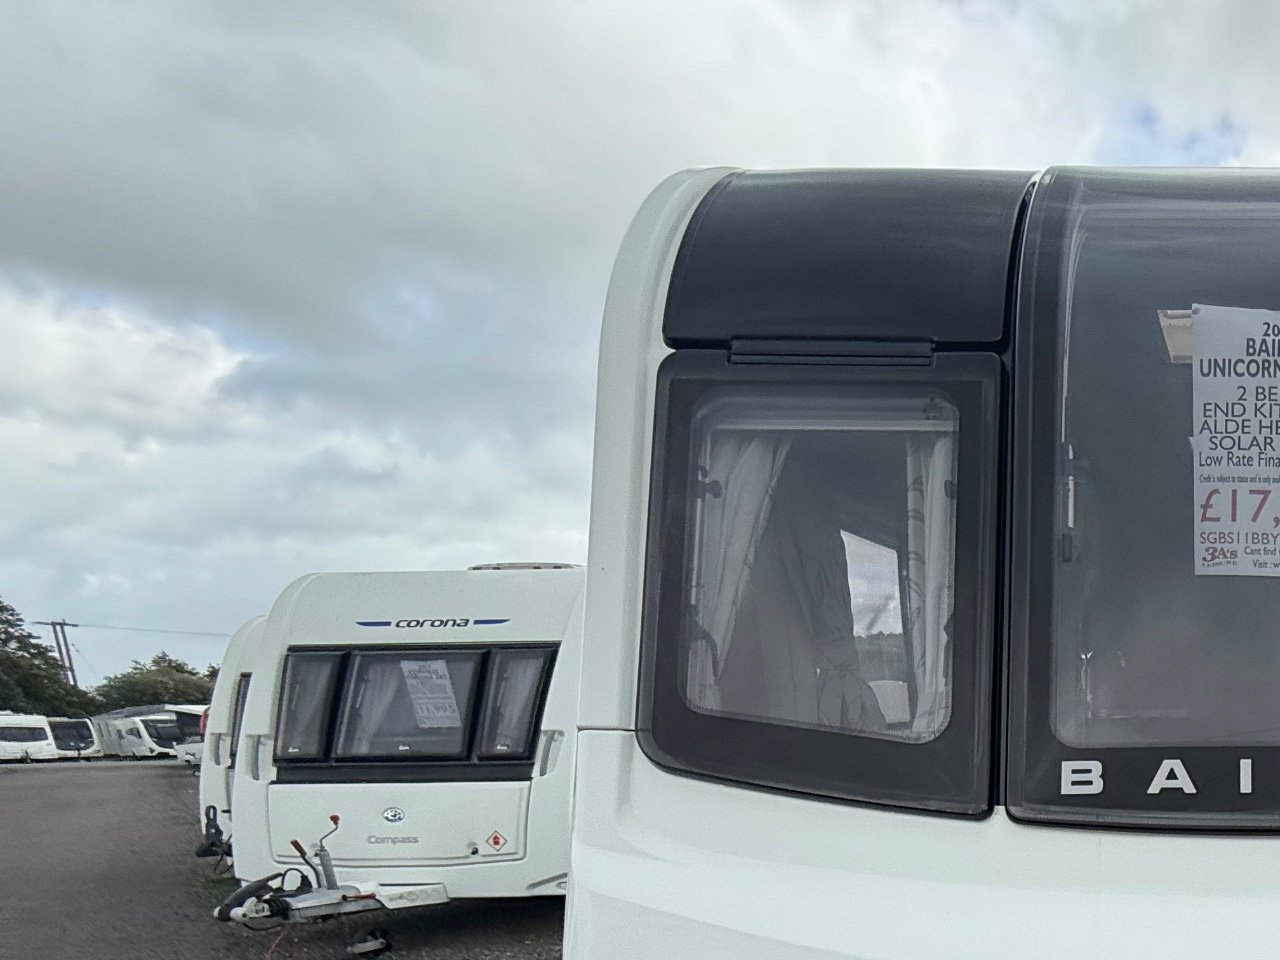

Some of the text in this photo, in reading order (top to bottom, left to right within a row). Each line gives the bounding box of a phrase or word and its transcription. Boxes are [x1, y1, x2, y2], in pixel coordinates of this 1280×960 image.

[1237, 386, 1248, 401] 2
[1203, 402, 1247, 418] END
[1199, 419, 1252, 435] ALDE
[1209, 435, 1276, 452] SOLAR
[1199, 452, 1224, 467] Low
[1227, 451, 1254, 467] Rate
[1202, 546, 1238, 562] 3A's
[1263, 546, 1277, 556] find
[395, 618, 470, 629] corona
[367, 835, 419, 846] Compass
